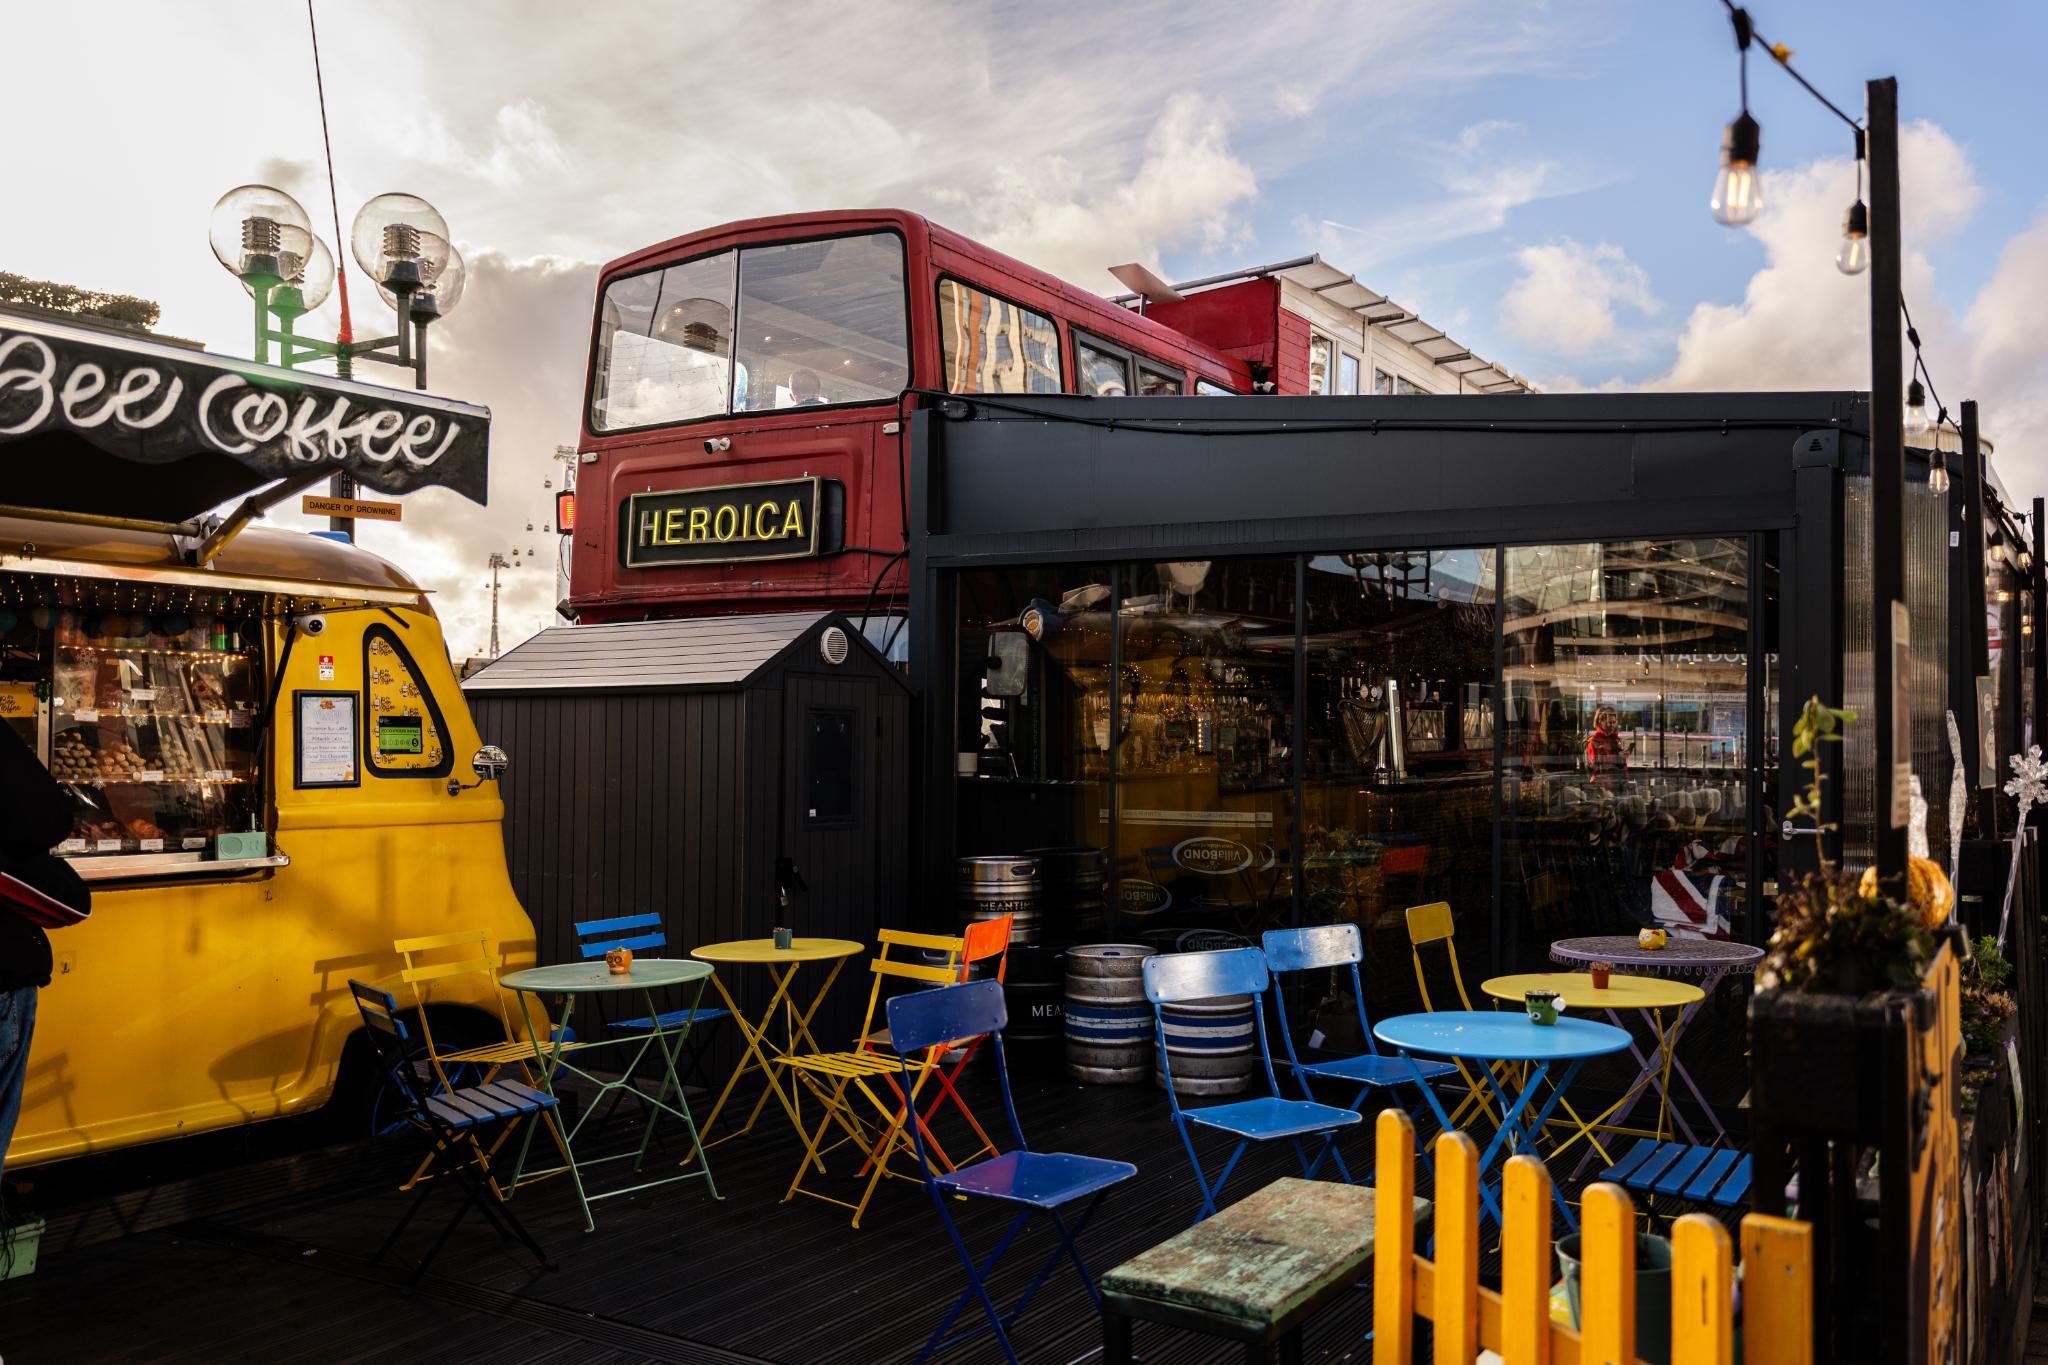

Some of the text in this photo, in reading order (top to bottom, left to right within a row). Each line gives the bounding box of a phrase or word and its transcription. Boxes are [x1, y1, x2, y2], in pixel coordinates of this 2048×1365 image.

[0, 335, 460, 465] Bee Coffee
[309, 501, 341, 510] DANGER
[356, 505, 396, 515] DROWNING
[639, 500, 805, 547] HEROICA
[1697, 692, 1710, 701] and
[1184, 848, 1242, 862] VillaBOND
